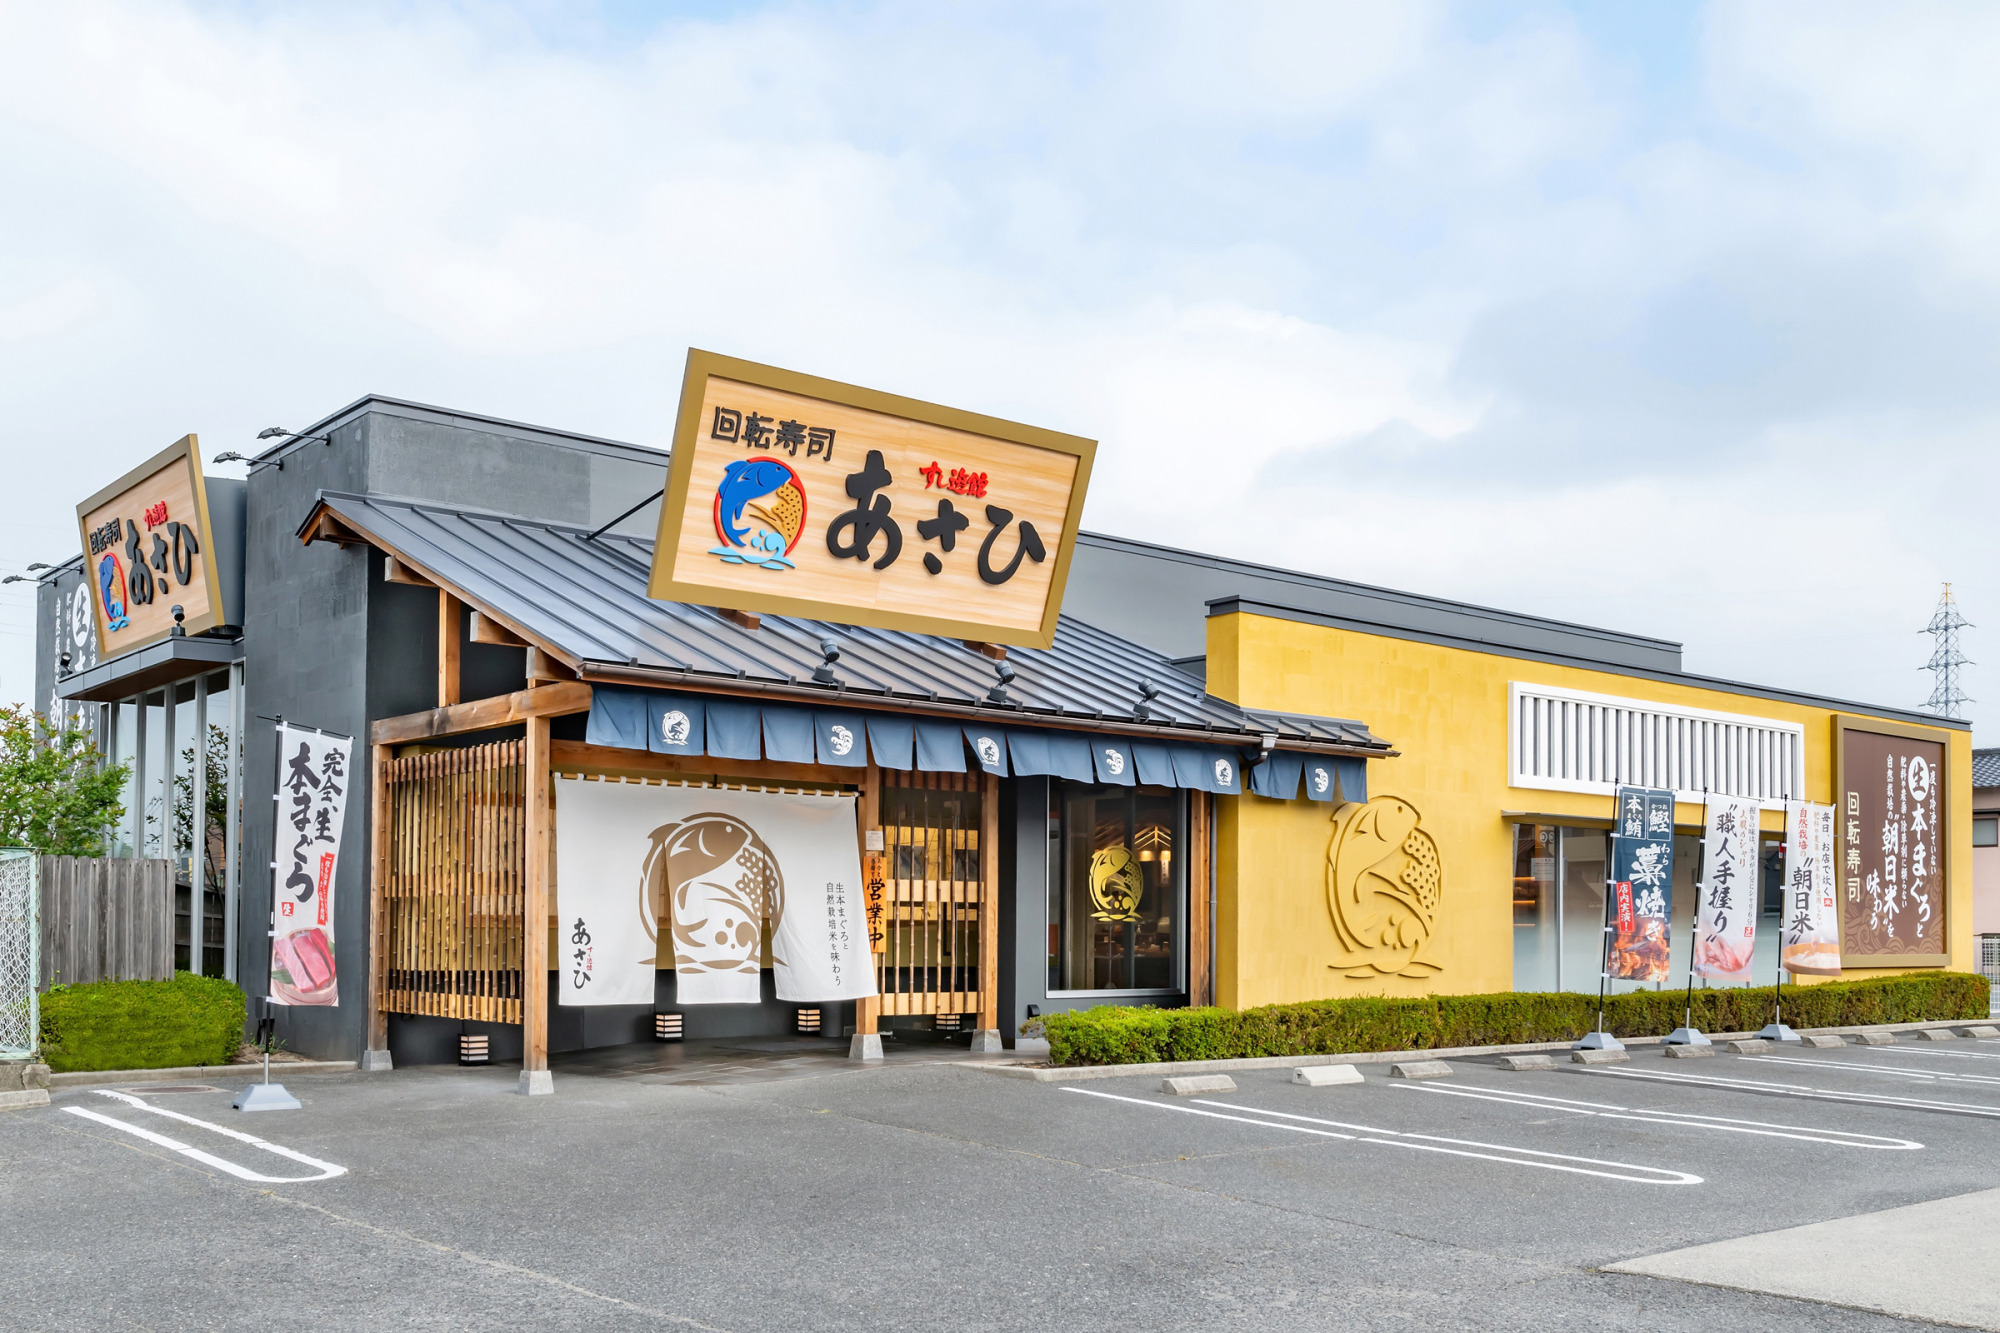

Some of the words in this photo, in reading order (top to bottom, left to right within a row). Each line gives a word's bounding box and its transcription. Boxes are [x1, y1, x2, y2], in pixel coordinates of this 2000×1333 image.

[711, 406, 836, 461] 回転寿司
[89, 517, 122, 555] 回転寿司
[826, 450, 1047, 585] あさひ
[125, 519, 199, 605] あさひ
[282, 741, 321, 903] 本まぐろ
[1822, 812, 1832, 897] 毎日、お店で炊く
[1847, 791, 1861, 903] 回転寿司
[1929, 763, 1937, 875] 一度も冷凍していない
[826, 882, 841, 986] 自然栽培米を味わう
[836, 882, 849, 950] 生本まぐろと
[866, 878, 885, 950] 営業中
[1866, 869, 1883, 931] 味わう
[571, 917, 591, 989] あさひ
